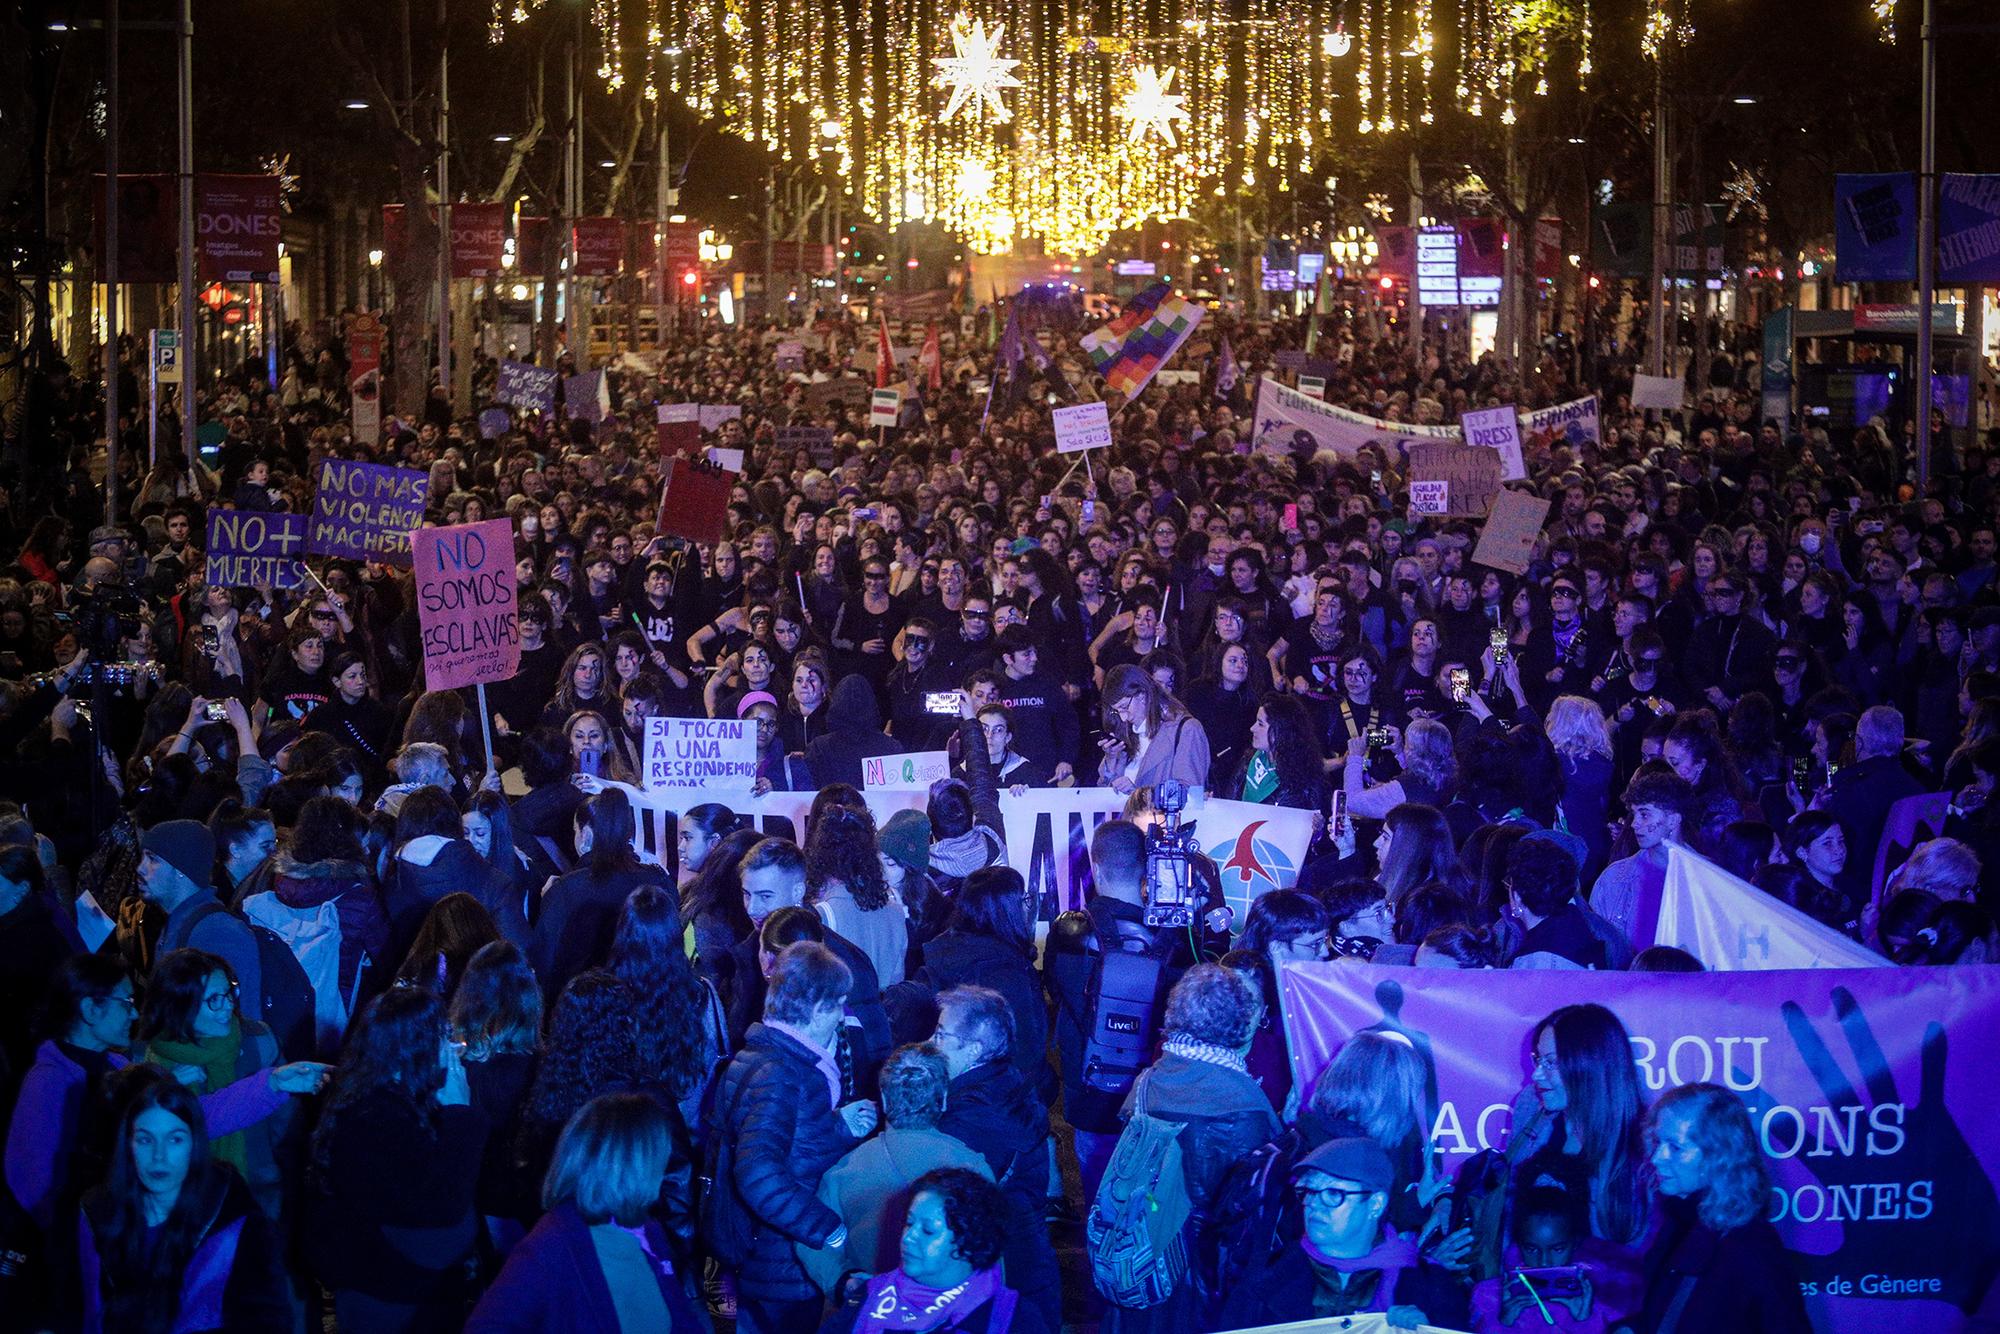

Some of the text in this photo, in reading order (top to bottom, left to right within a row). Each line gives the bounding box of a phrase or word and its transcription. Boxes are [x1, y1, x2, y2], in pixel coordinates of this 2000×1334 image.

[199, 213, 280, 235] DONES
[1473, 426, 1513, 446] DRESS
[321, 461, 428, 504] NO MAS
[321, 497, 423, 529] VIOLENCIA
[435, 531, 486, 573] NO
[206, 556, 306, 589] MUERTES
[422, 570, 512, 612] SOMOS
[424, 613, 519, 658] ESCLAVAS
[652, 721, 743, 739] SI TOCAN
[652, 740, 721, 759] A UNA
[652, 761, 756, 777] RESPONDEMOS
[1628, 1035, 1769, 1092] ROU
[1826, 1275, 1852, 1295] de
[1860, 1274, 1942, 1294] Gènere
